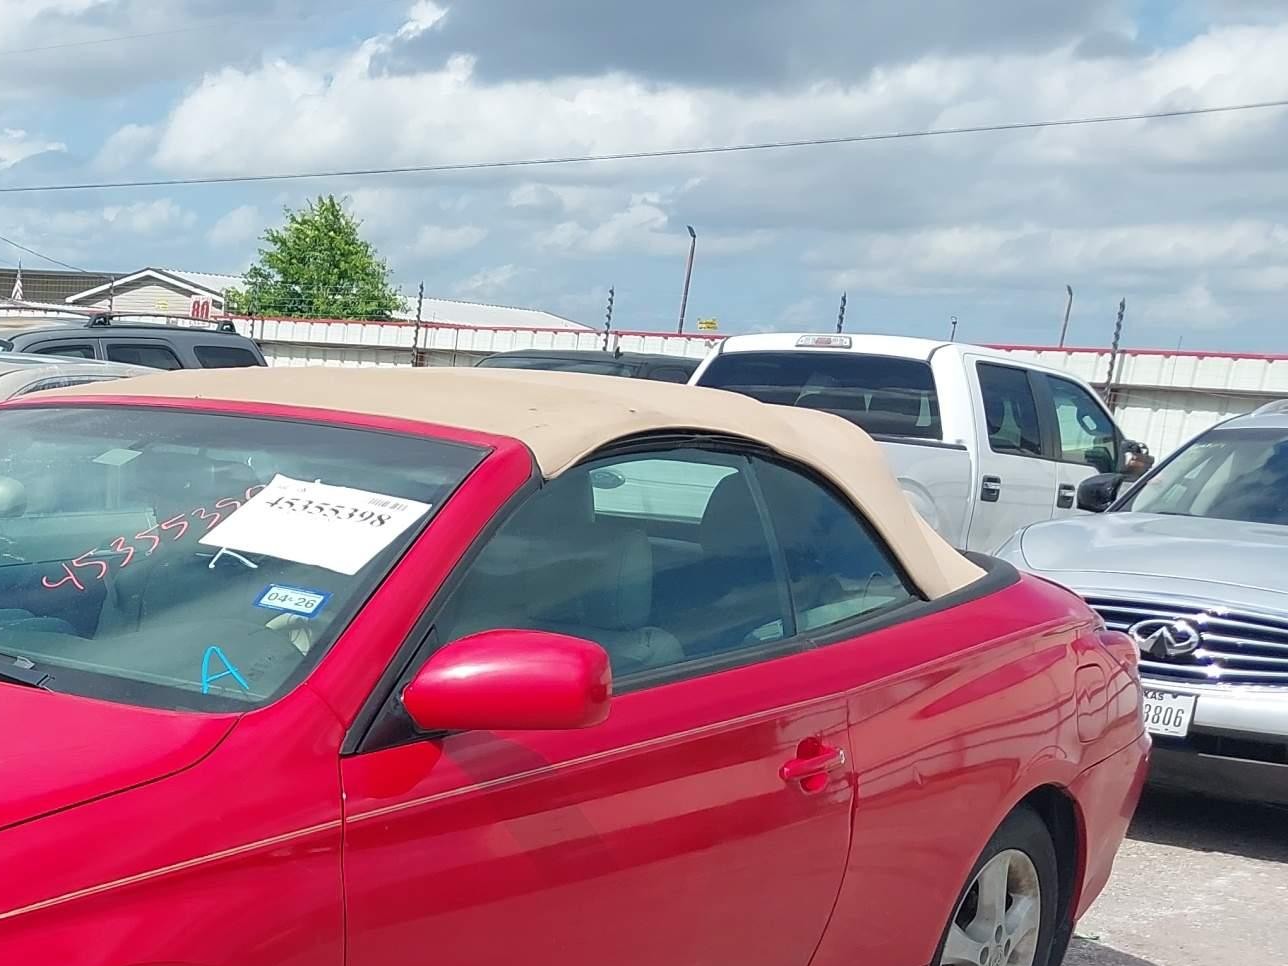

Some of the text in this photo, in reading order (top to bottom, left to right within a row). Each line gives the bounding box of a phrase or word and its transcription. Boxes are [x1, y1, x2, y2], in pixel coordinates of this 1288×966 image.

[192, 300, 210, 319] 80
[265, 496, 392, 528] 45355398
[202, 645, 250, 695] A
